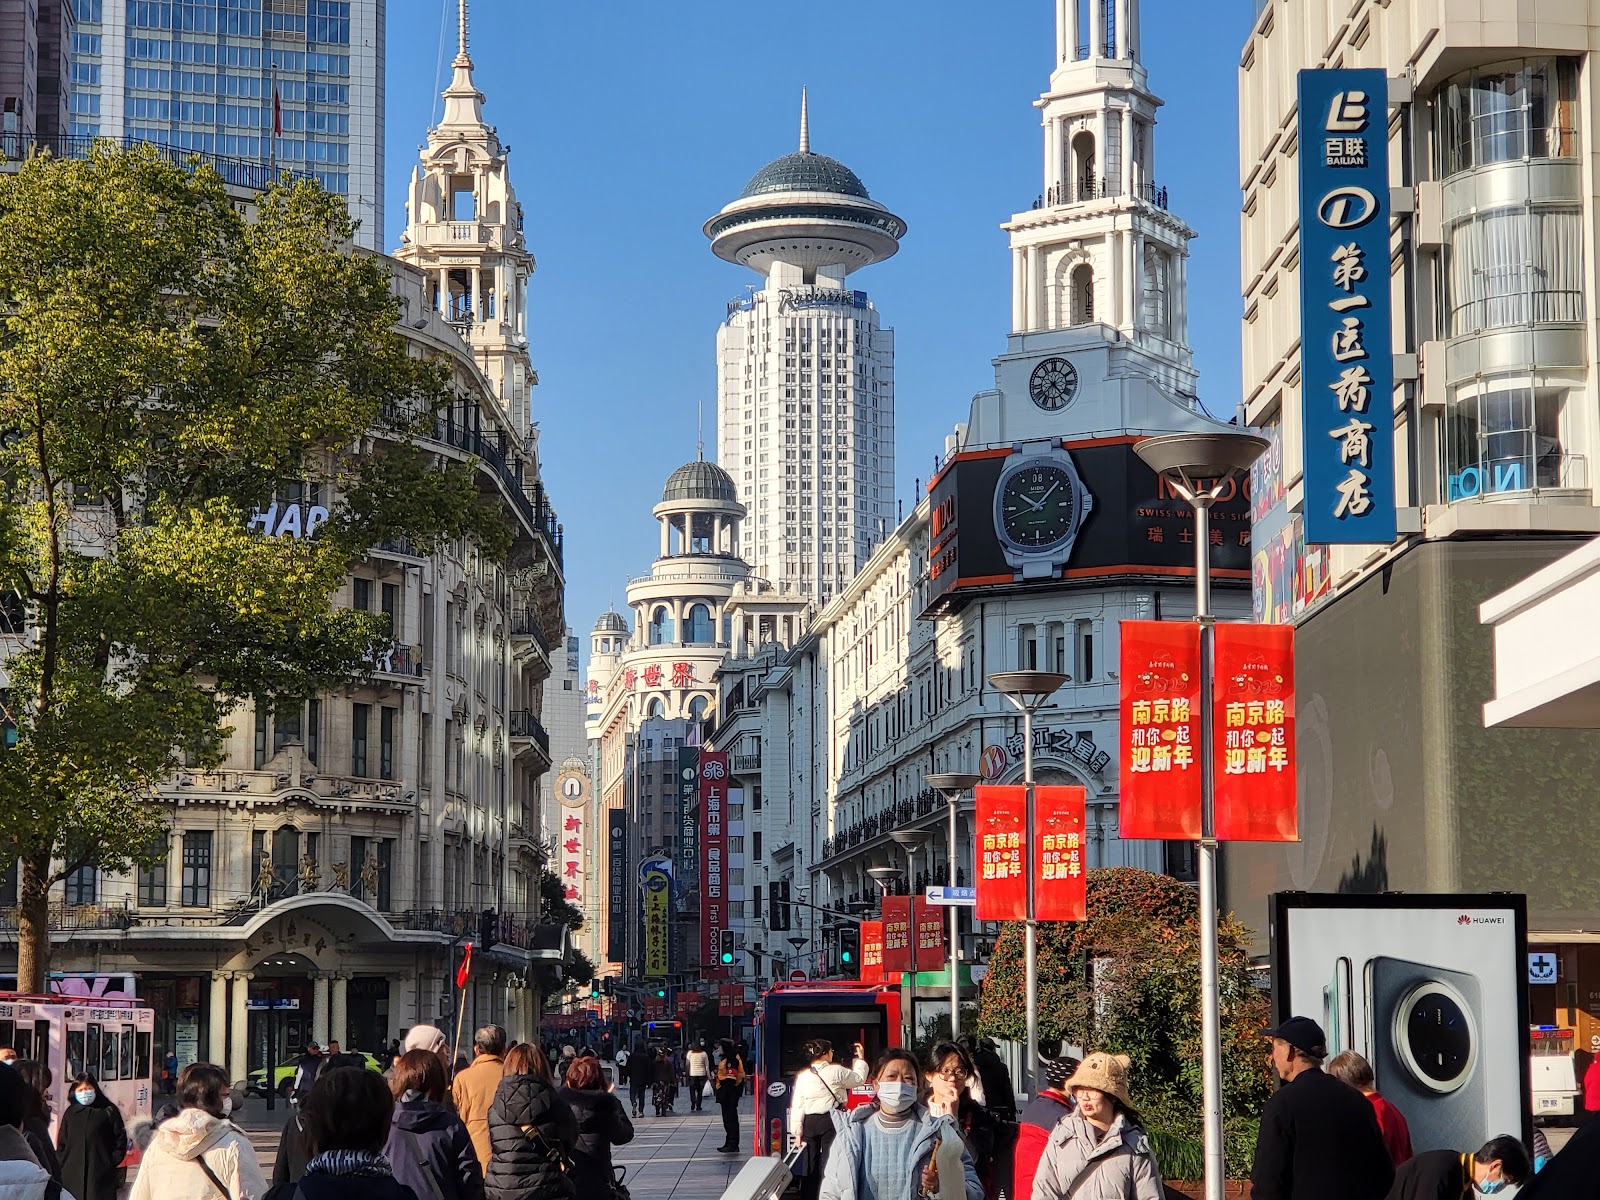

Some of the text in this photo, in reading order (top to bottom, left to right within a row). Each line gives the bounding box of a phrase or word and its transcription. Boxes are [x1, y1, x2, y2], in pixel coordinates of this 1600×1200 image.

[1325, 138, 1364, 156] 百联
[1326, 156, 1364, 165] BAILIAN
[778, 284, 853, 314] Radisson
[1328, 242, 1372, 518] 第一医药商店
[1032, 473, 1043, 483] 08
[1138, 508, 1171, 517] SWISS
[625, 662, 694, 689] 新世界
[1132, 697, 1191, 725] 南京路
[1226, 699, 1286, 727] 南京路
[1131, 745, 1193, 773] 迎新年
[1225, 746, 1288, 774] 迎新年
[708, 786, 720, 898] 上海市第一食品商店
[983, 832, 1019, 850] 南京路
[1043, 832, 1079, 850] 南京路
[982, 862, 1021, 879] 迎新年
[1041, 862, 1081, 880] 迎新年
[709, 904, 719, 923] First
